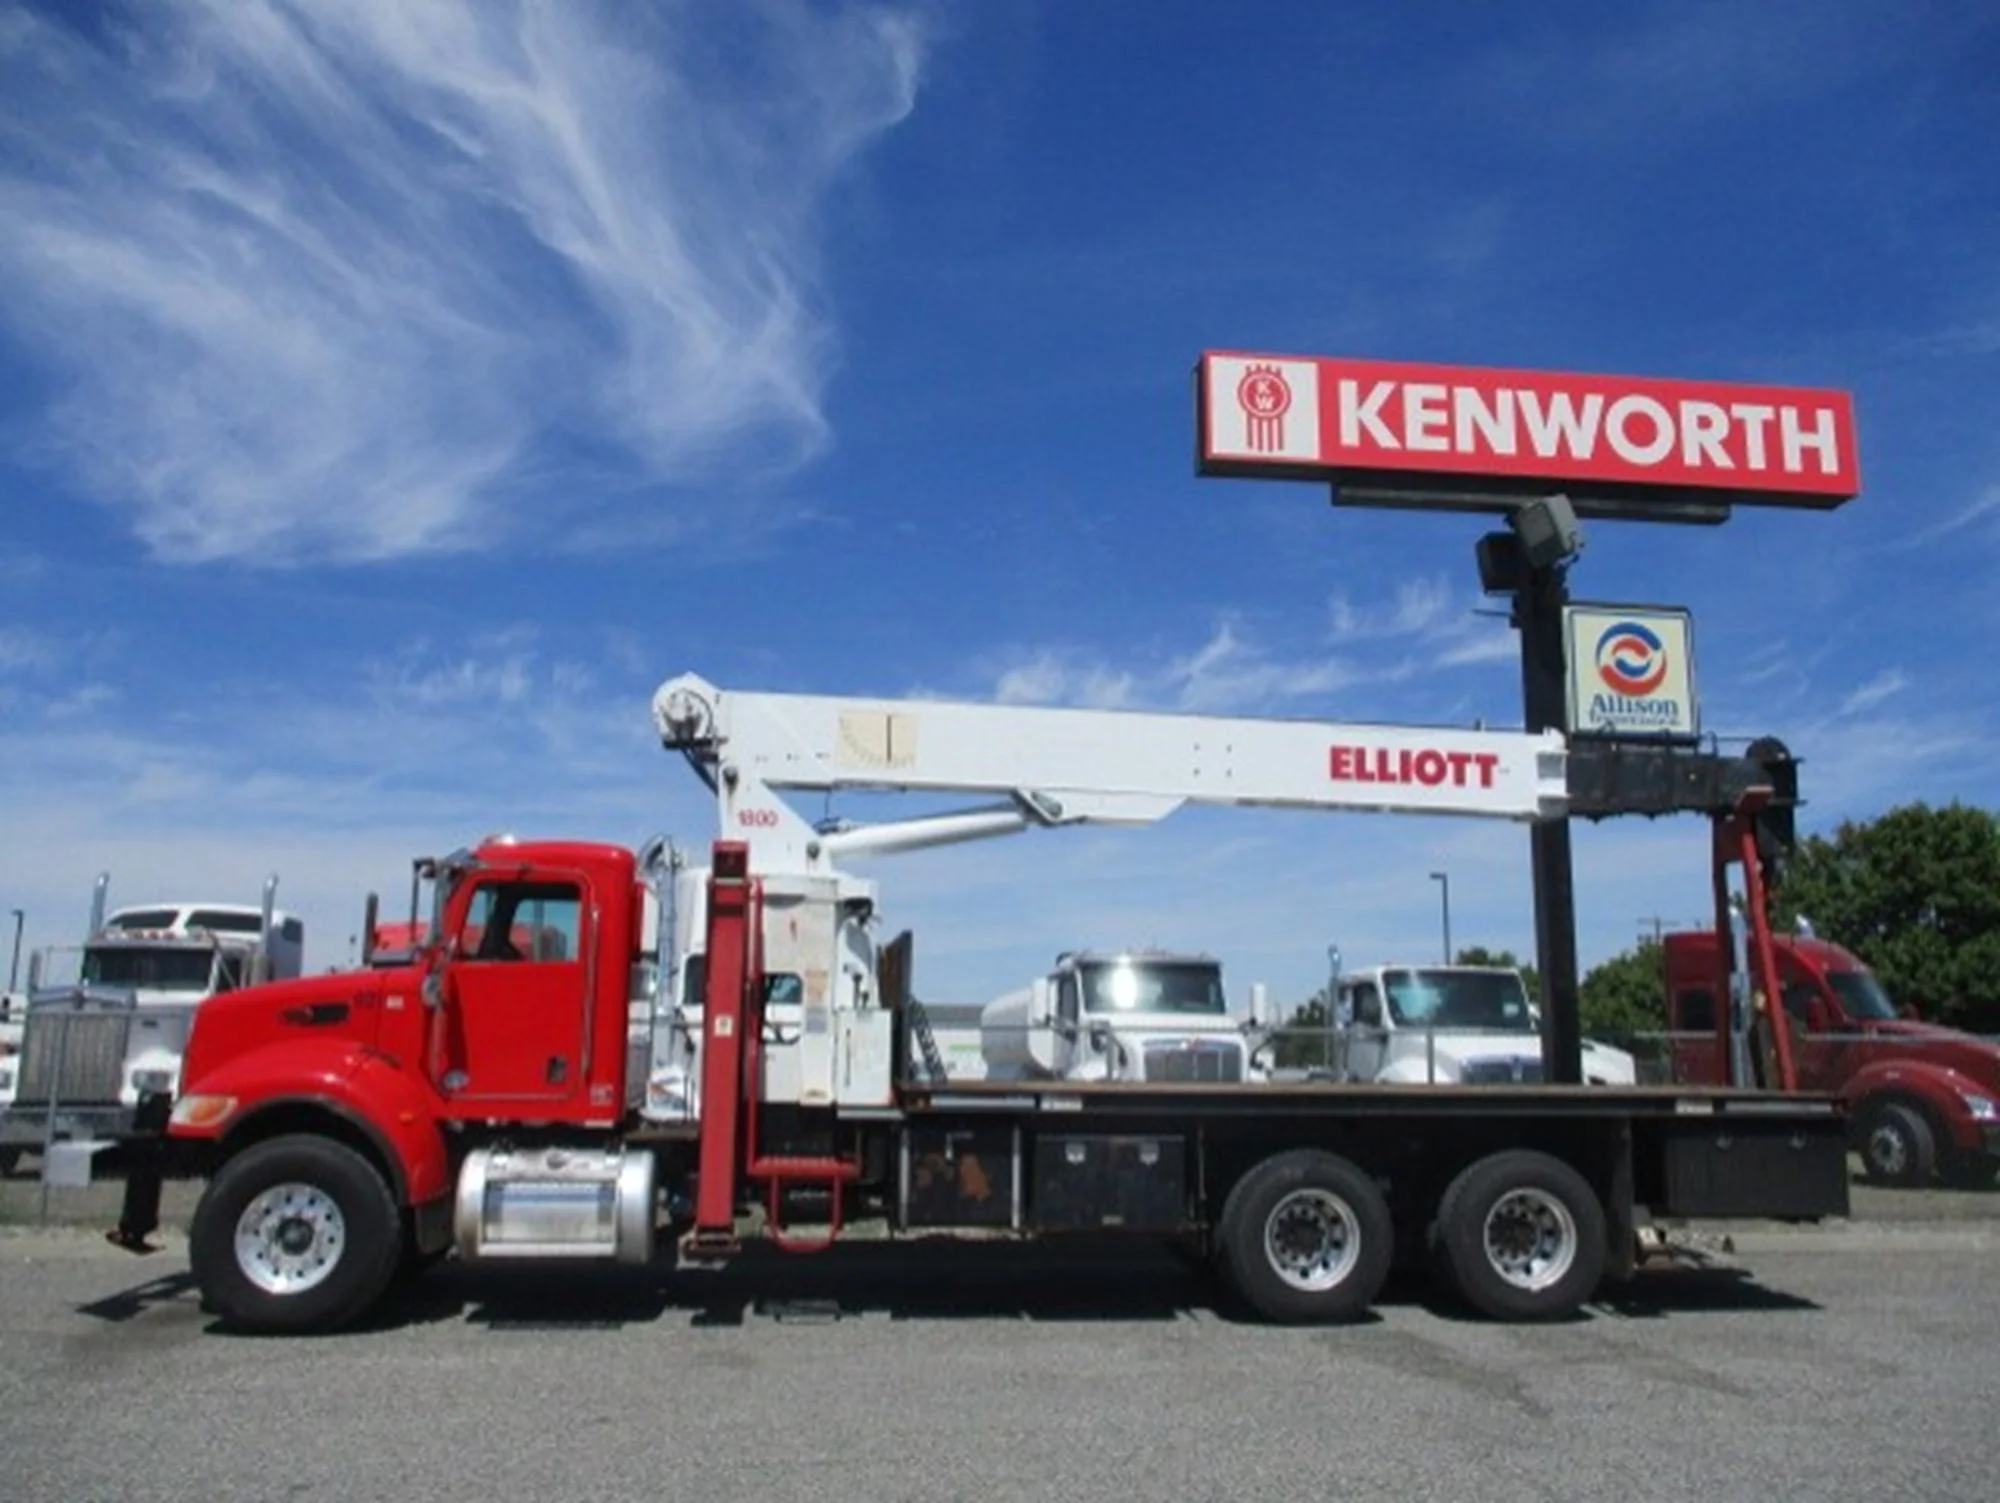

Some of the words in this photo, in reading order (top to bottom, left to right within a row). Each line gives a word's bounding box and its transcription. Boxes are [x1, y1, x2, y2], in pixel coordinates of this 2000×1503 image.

[1338, 379, 1840, 474] KENWORTH
[1589, 693, 1679, 716] Allison
[1330, 746, 1498, 788] ELLIOTT
[739, 808, 779, 828] 1800
